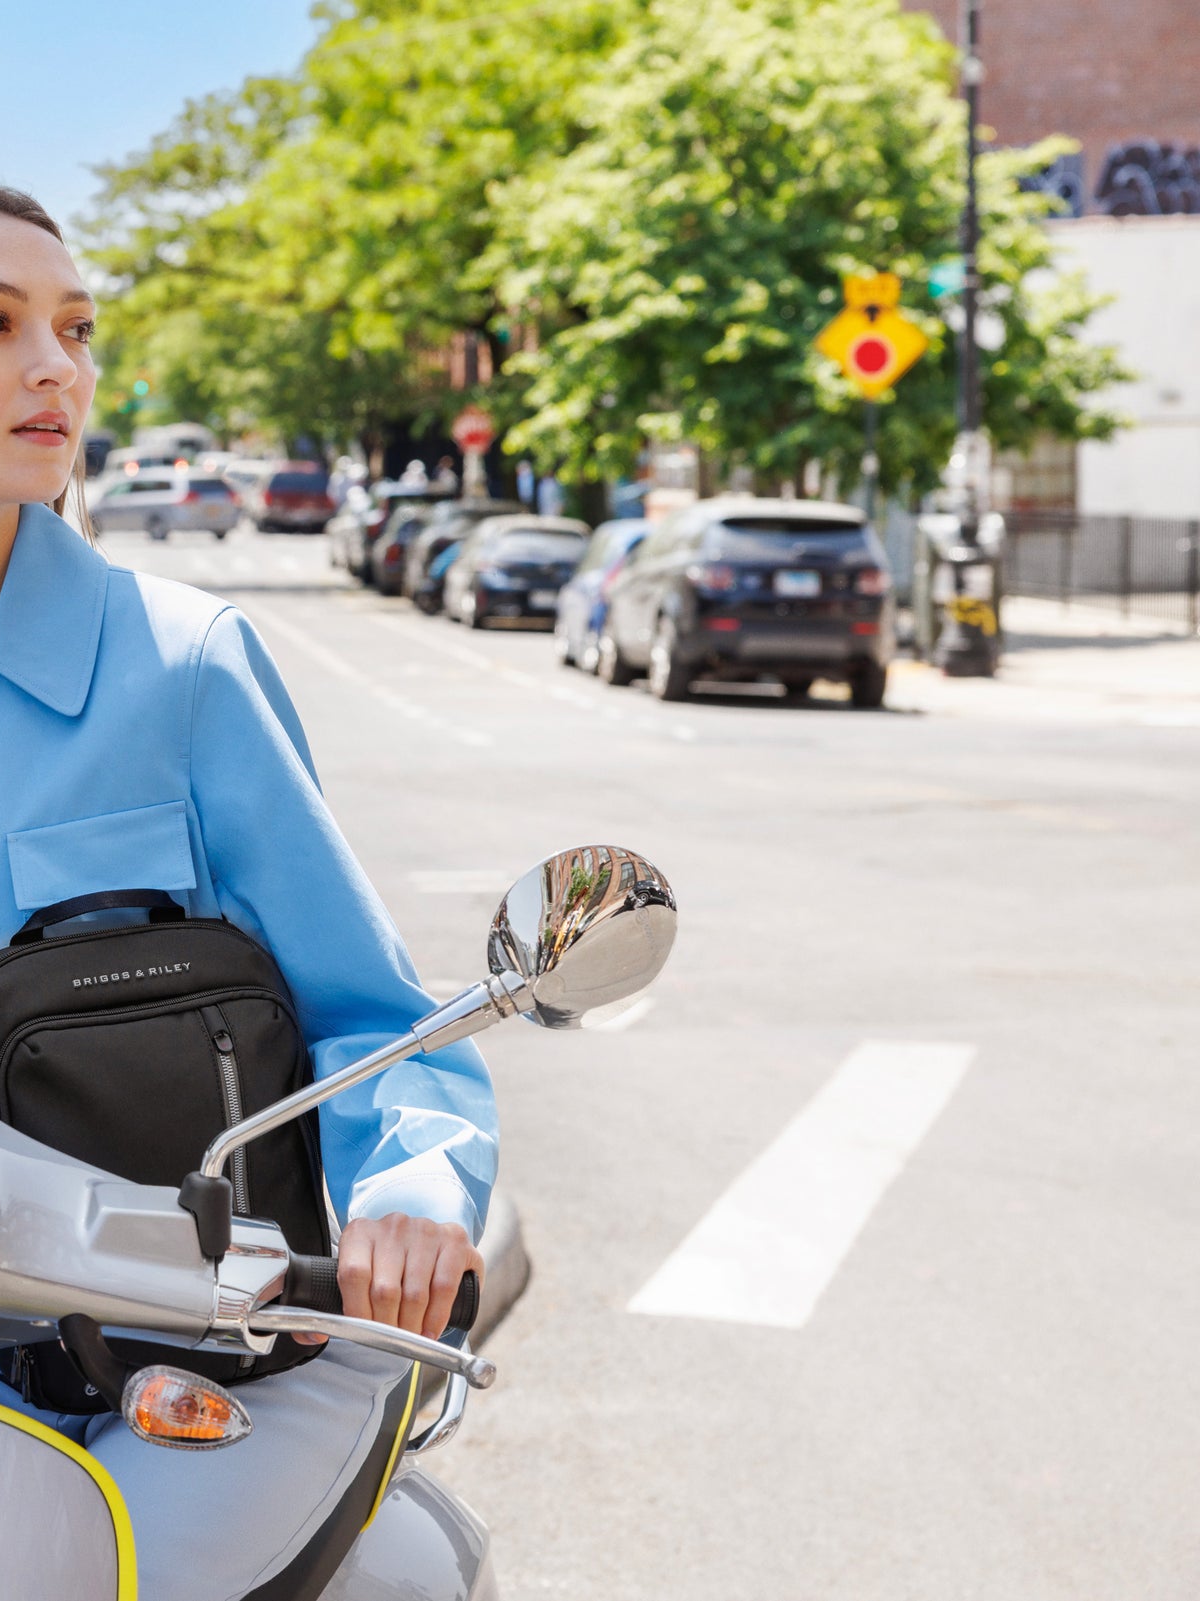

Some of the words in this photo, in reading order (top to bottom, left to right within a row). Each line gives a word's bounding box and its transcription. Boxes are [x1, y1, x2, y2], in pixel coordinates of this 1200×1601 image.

[72, 971, 130, 987] BRIGGS
[135, 969, 145, 977] &
[148, 962, 191, 976] RILEY
